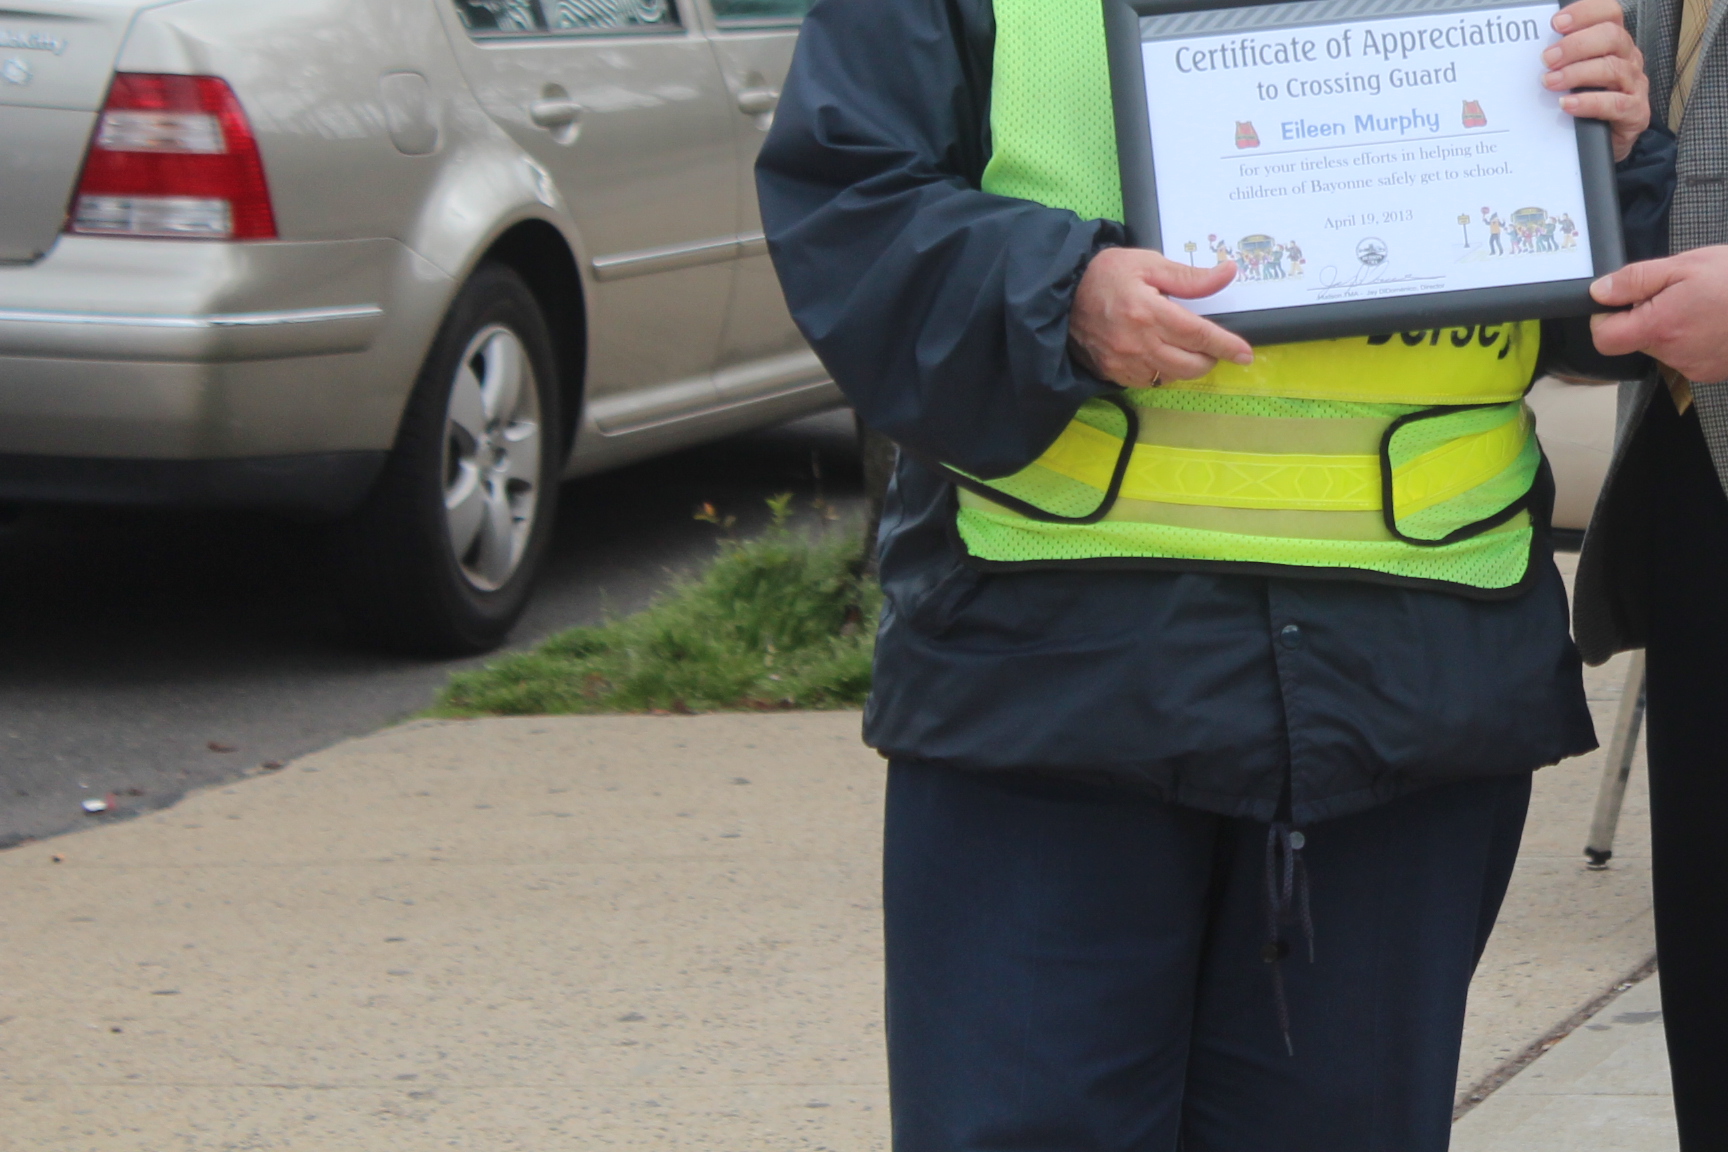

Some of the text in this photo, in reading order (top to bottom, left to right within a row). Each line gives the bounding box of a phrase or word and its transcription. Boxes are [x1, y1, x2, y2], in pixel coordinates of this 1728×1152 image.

[1175, 15, 1540, 74] Certificate of Appreciation
[1257, 61, 1458, 102] to Crossing Guard
[1281, 108, 1440, 141] Eileen Murphy
[1239, 140, 1498, 178] for your tireless efforts in helping the
[1229, 161, 1513, 201] children of Bayonne safely get to school.
[1324, 209, 1414, 230] April 19, 2013
